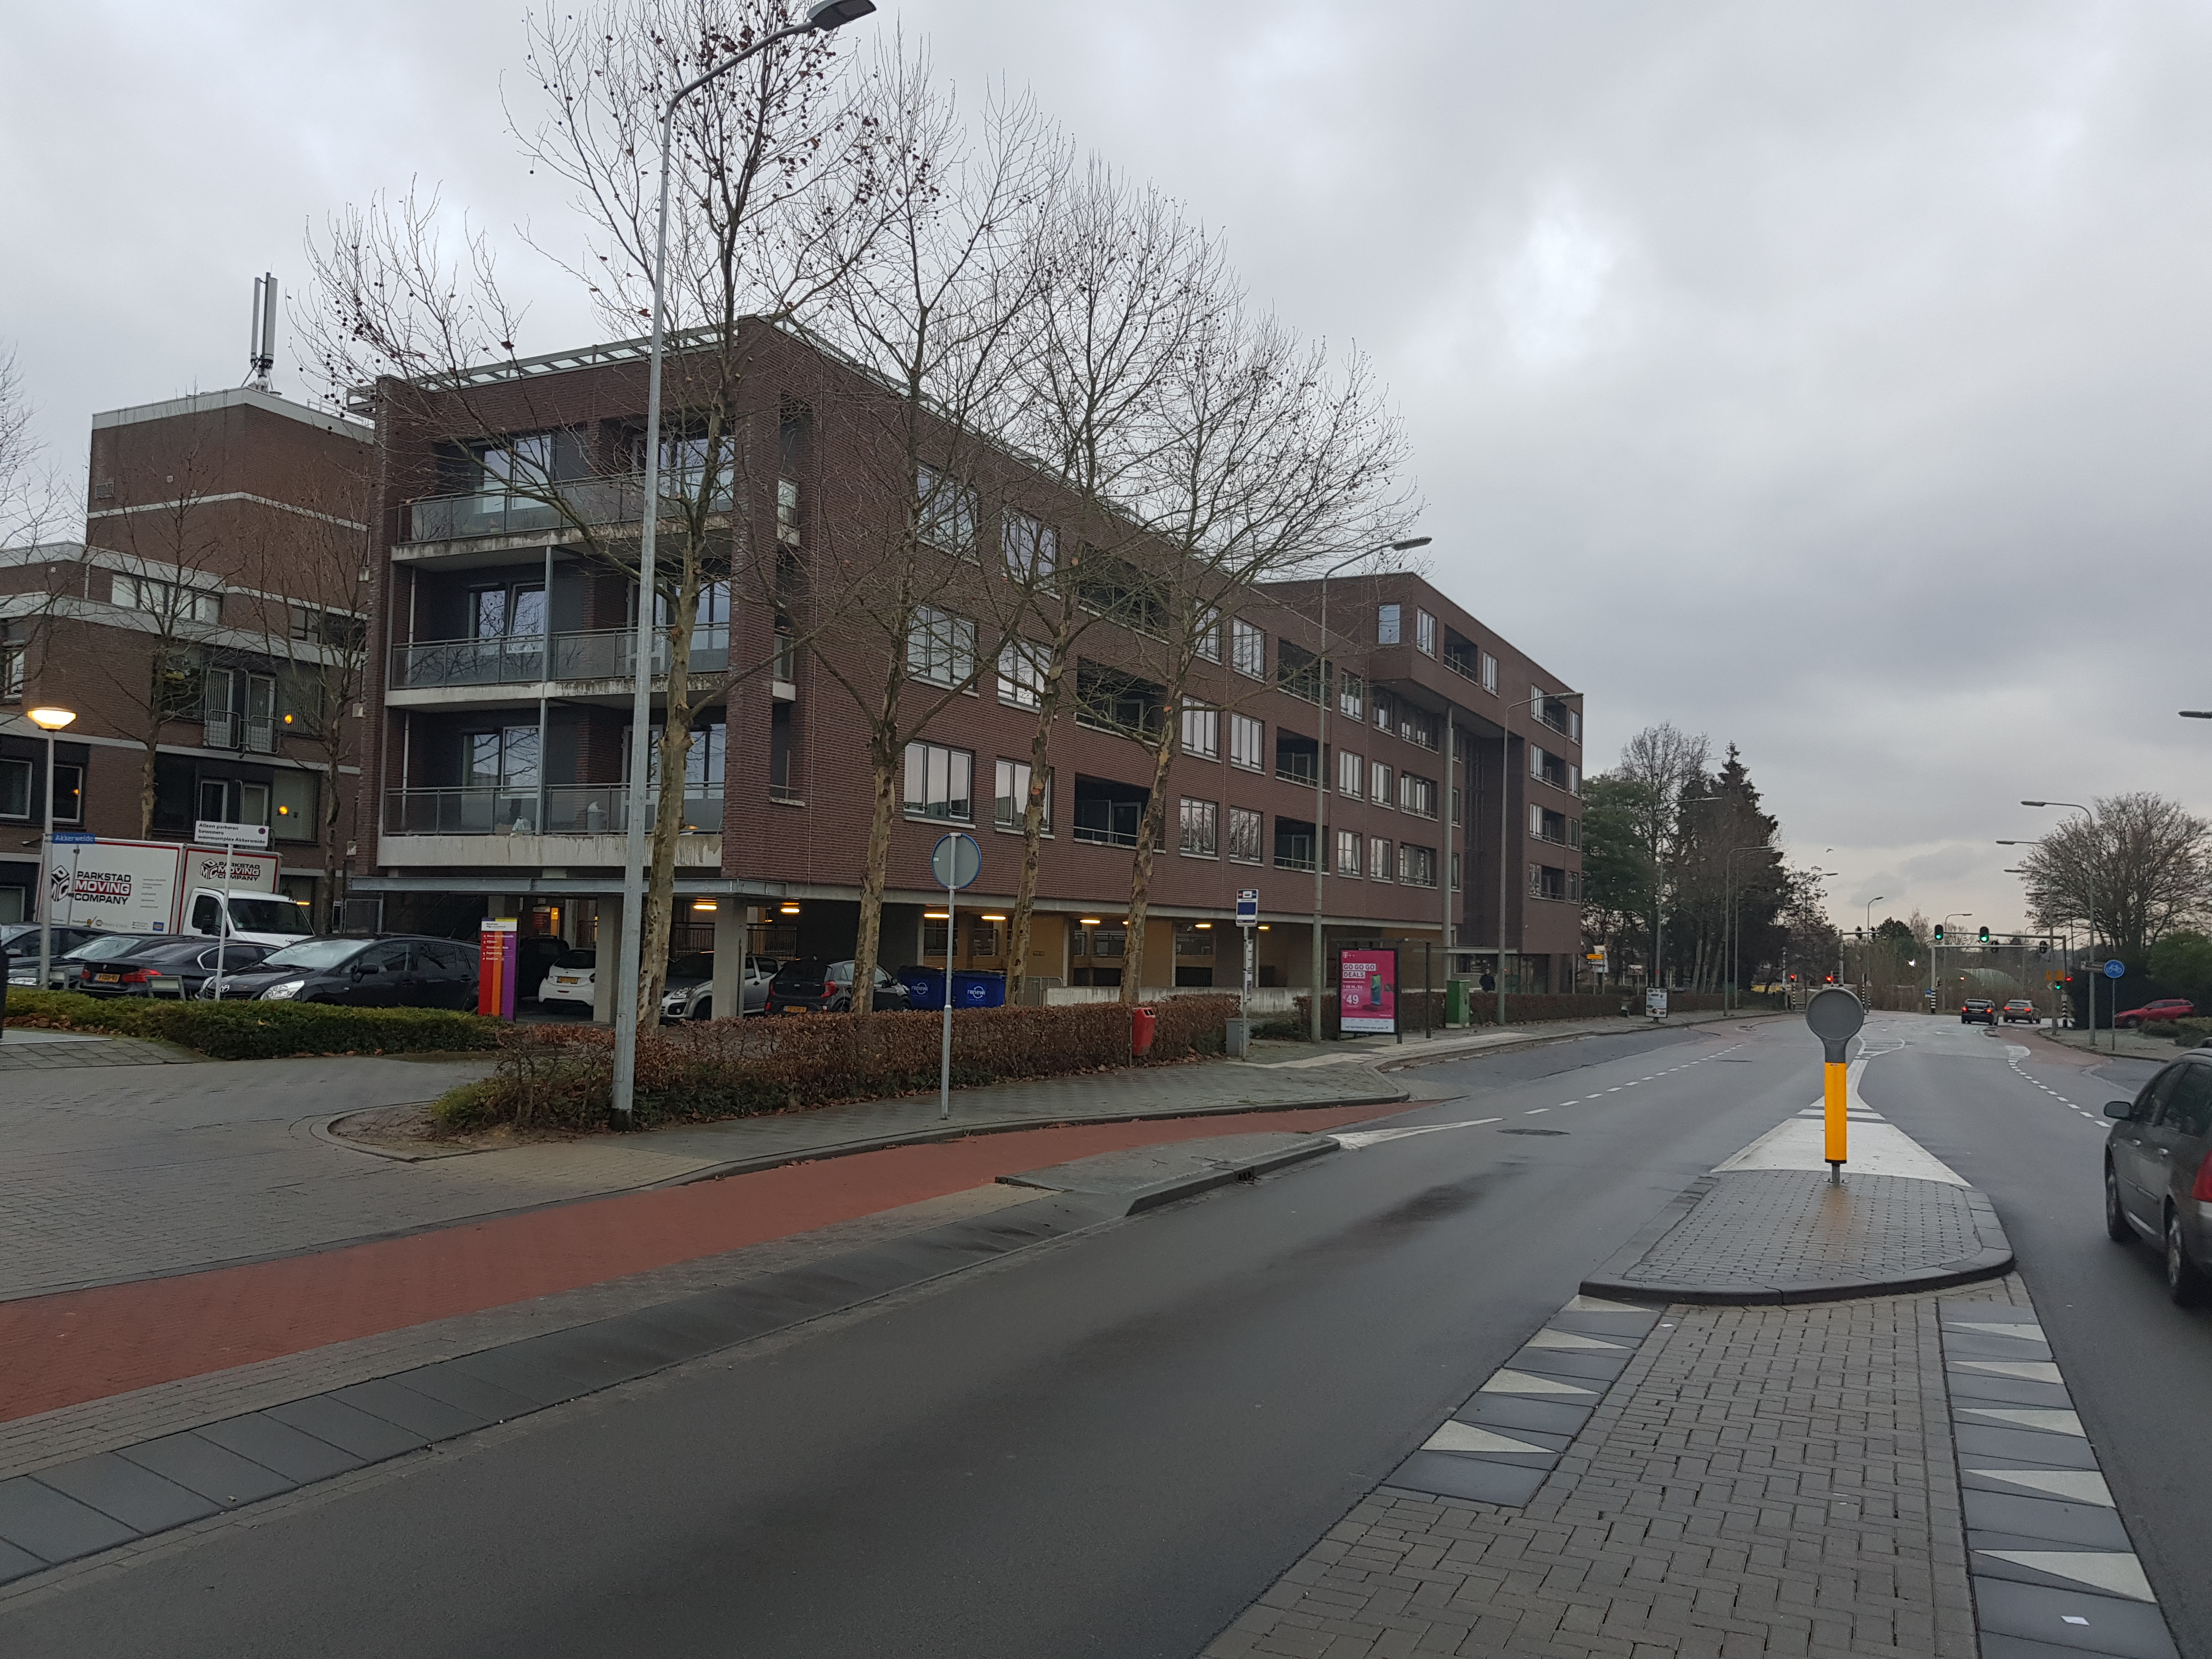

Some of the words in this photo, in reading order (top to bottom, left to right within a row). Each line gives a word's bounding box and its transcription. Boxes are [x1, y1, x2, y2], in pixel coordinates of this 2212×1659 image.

[77, 871, 131, 882] PARKSTAD
[75, 879, 131, 895] MOVING
[74, 893, 128, 905] COMPANY
